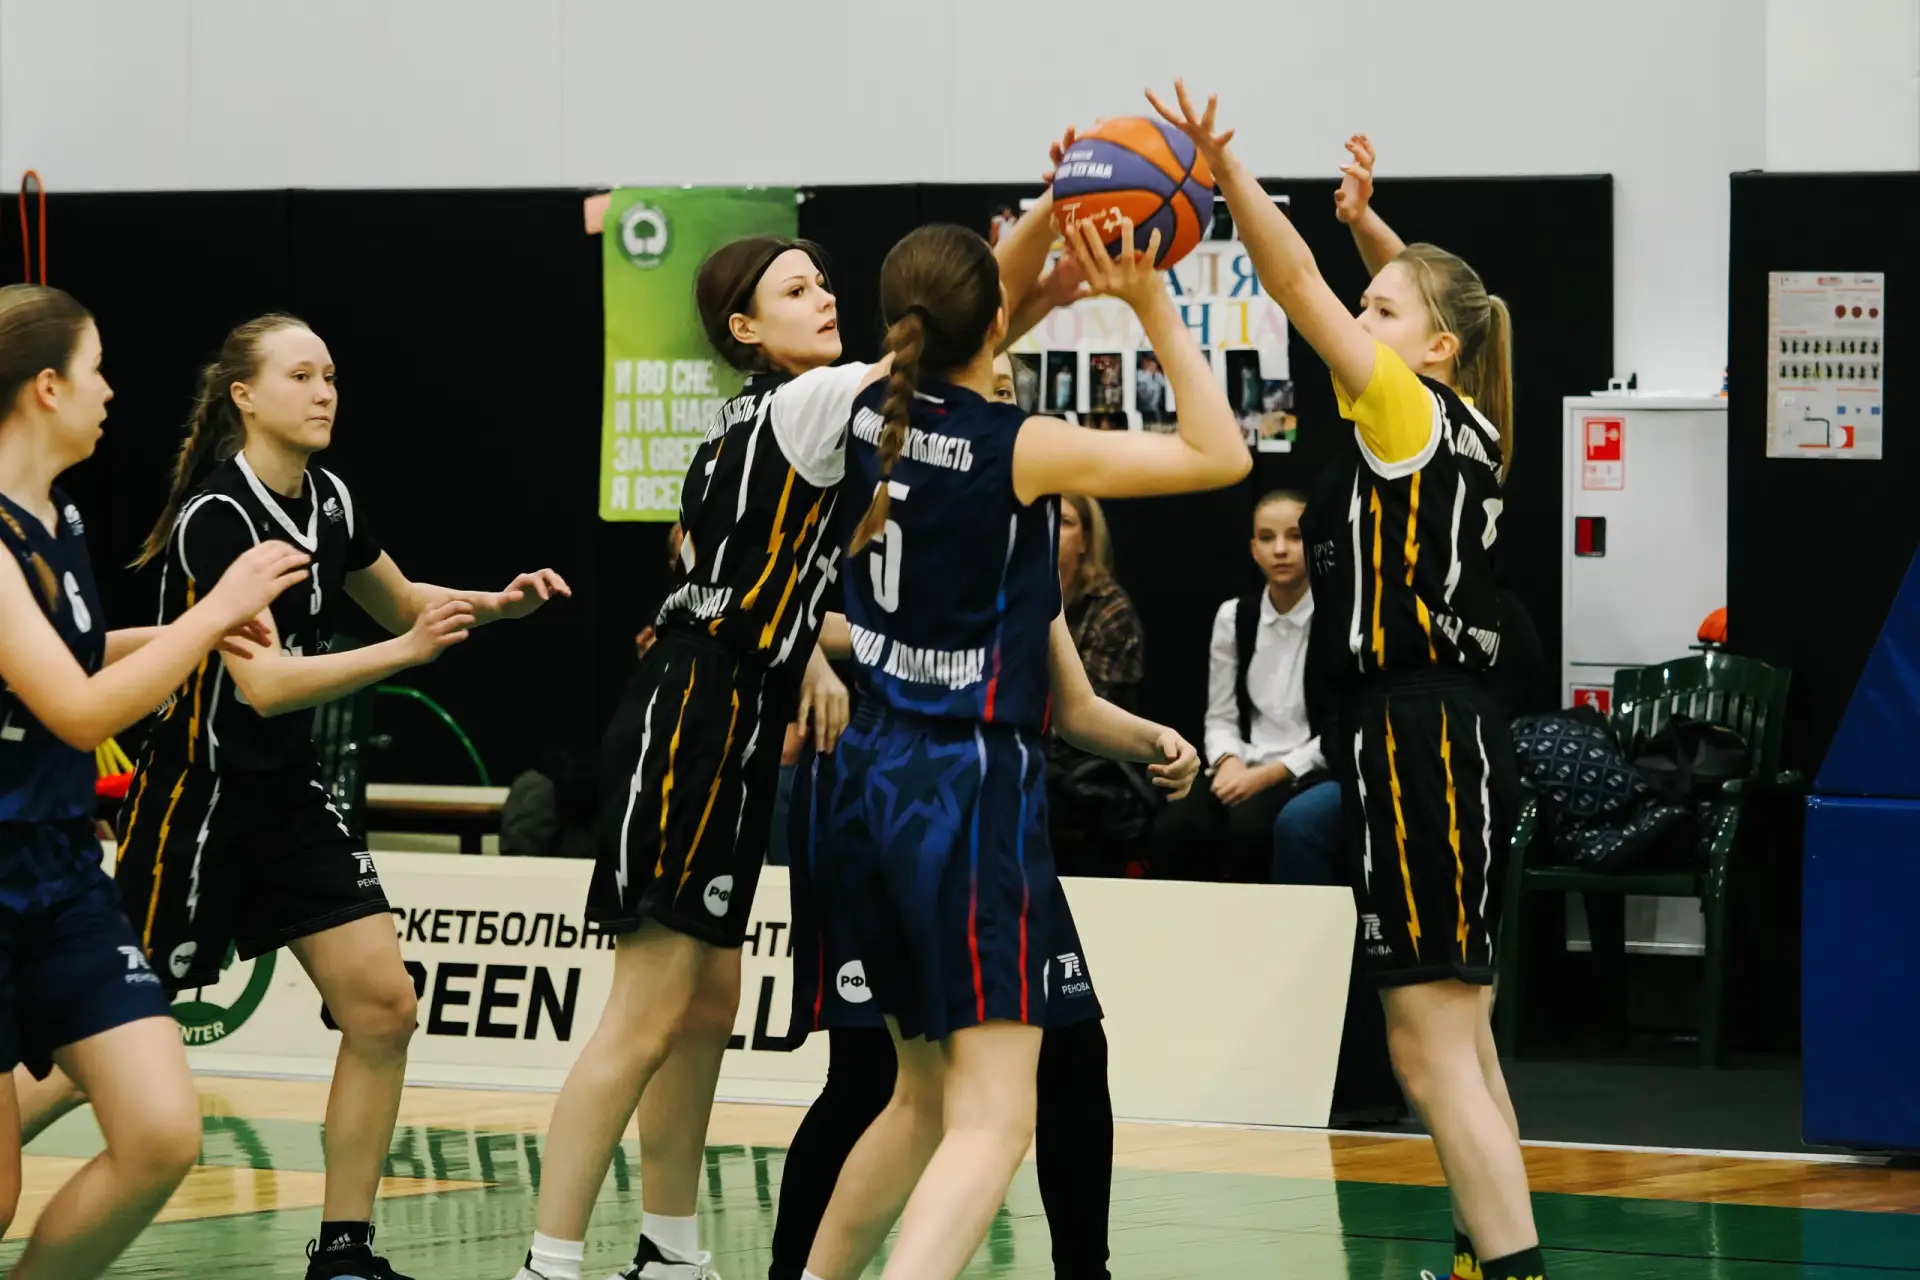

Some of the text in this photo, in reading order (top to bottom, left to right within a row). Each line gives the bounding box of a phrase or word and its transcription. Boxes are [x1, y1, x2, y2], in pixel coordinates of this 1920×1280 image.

[614, 360, 632, 395] И
[636, 360, 668, 395] ВО
[614, 397, 728, 434] И НА НАЯ
[613, 437, 645, 472] ЗА
[611, 476, 683, 511] Я ВСЕ
[869, 480, 910, 613] 5
[63, 571, 92, 633] 6
[883, 640, 985, 690] КОМАНДА!
[320, 960, 582, 1041] EEN
[1061, 981, 1091, 995] РЕНОВА
[179, 1020, 226, 1043] NTER
